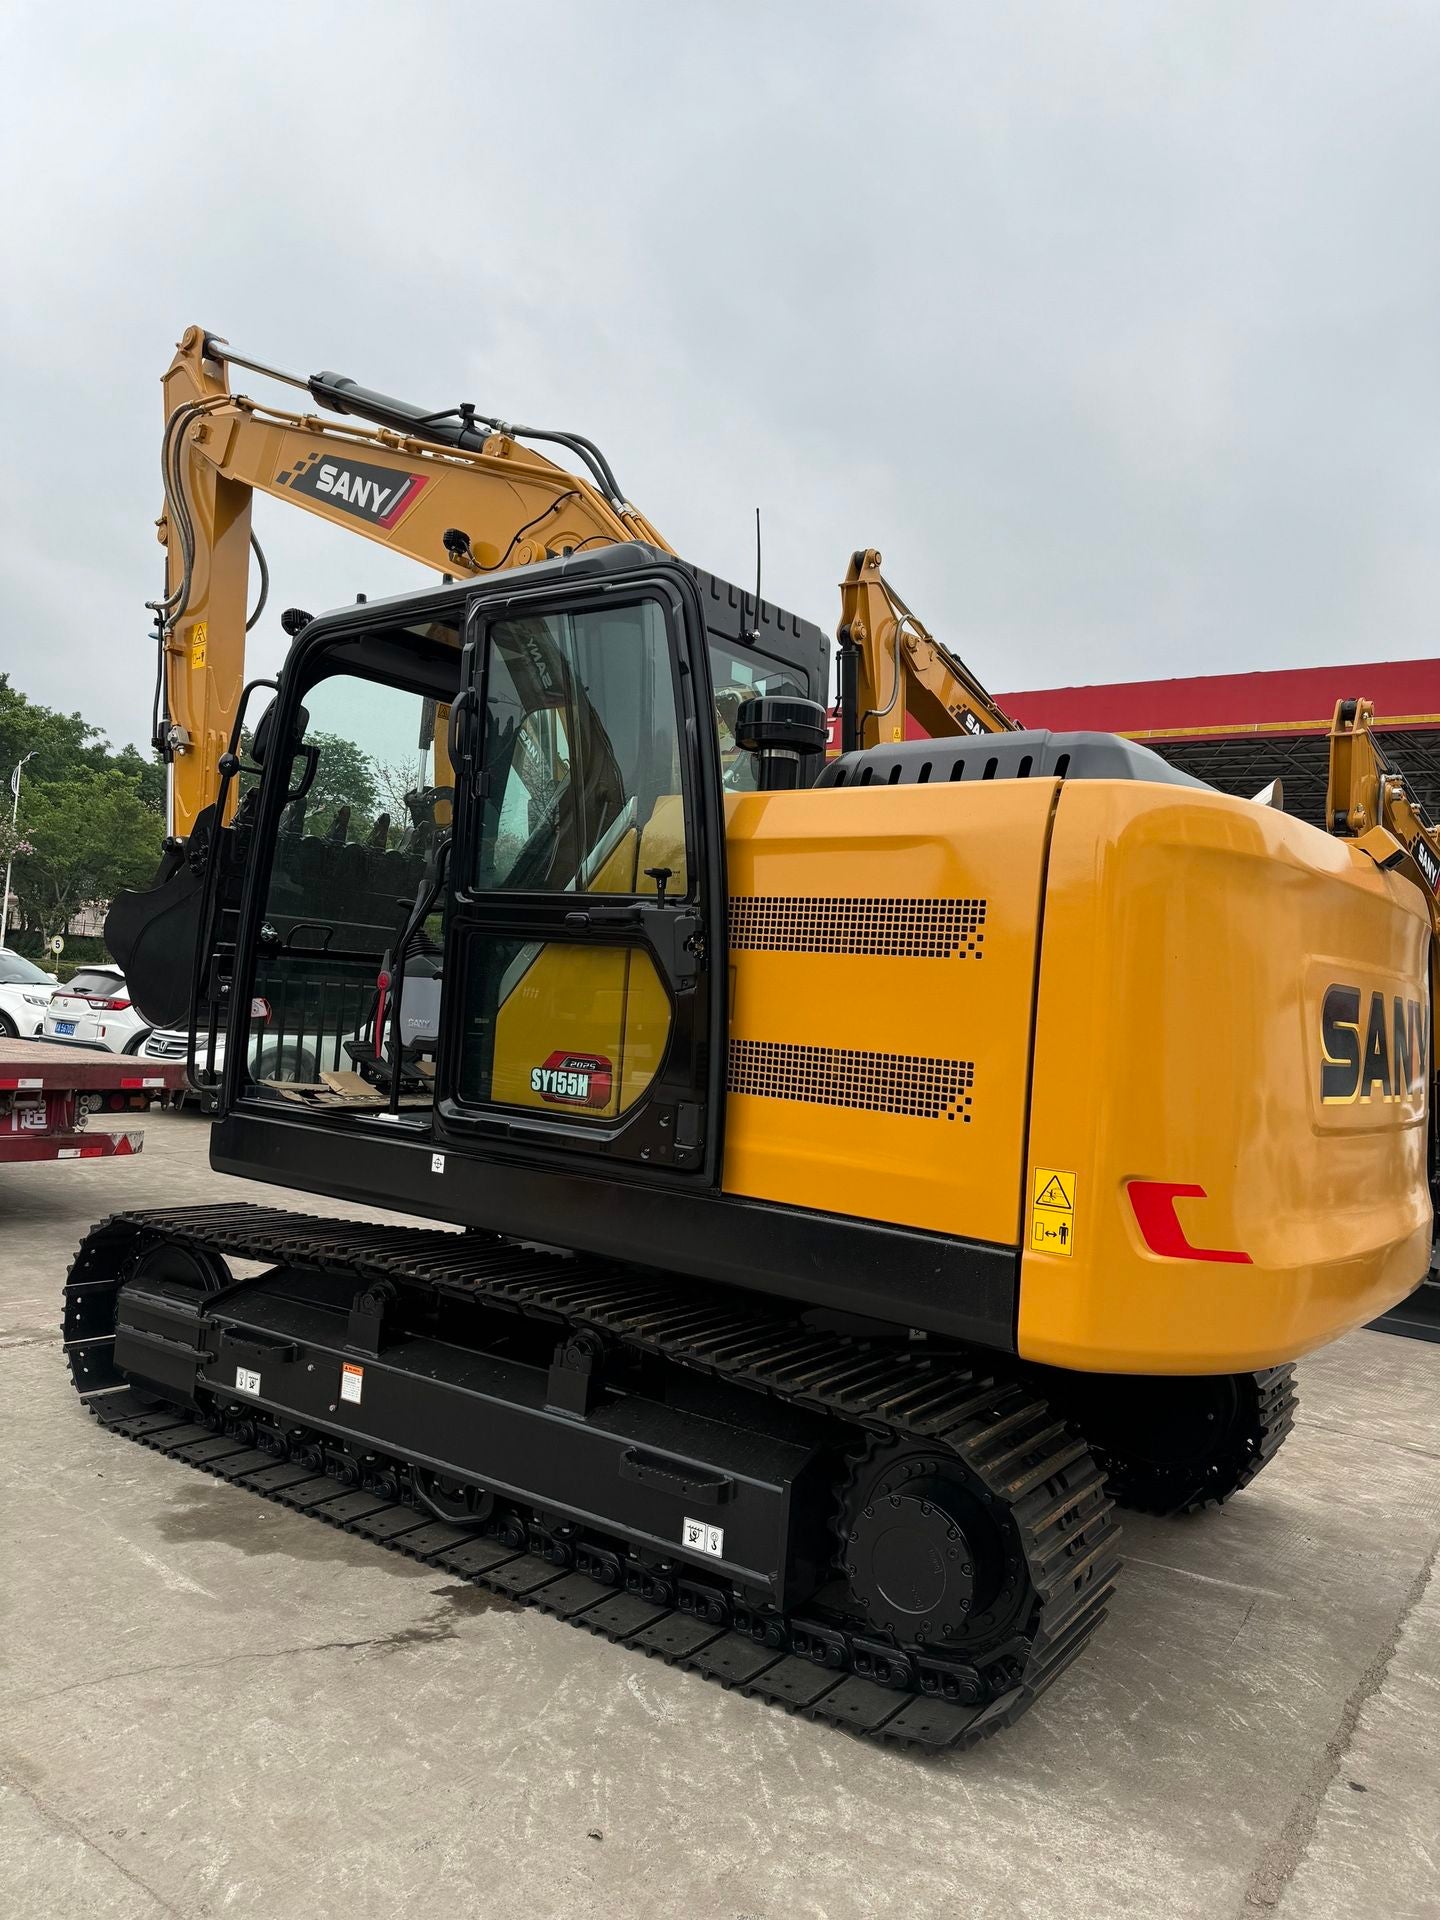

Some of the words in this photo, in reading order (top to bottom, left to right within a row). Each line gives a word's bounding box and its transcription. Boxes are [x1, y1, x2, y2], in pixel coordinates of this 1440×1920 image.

[315, 463, 392, 513] SANY
[1418, 842, 1437, 884] SANY
[55, 940, 60, 948] 5
[569, 1060, 597, 1070] 2025
[530, 1068, 589, 1097] SY155H
